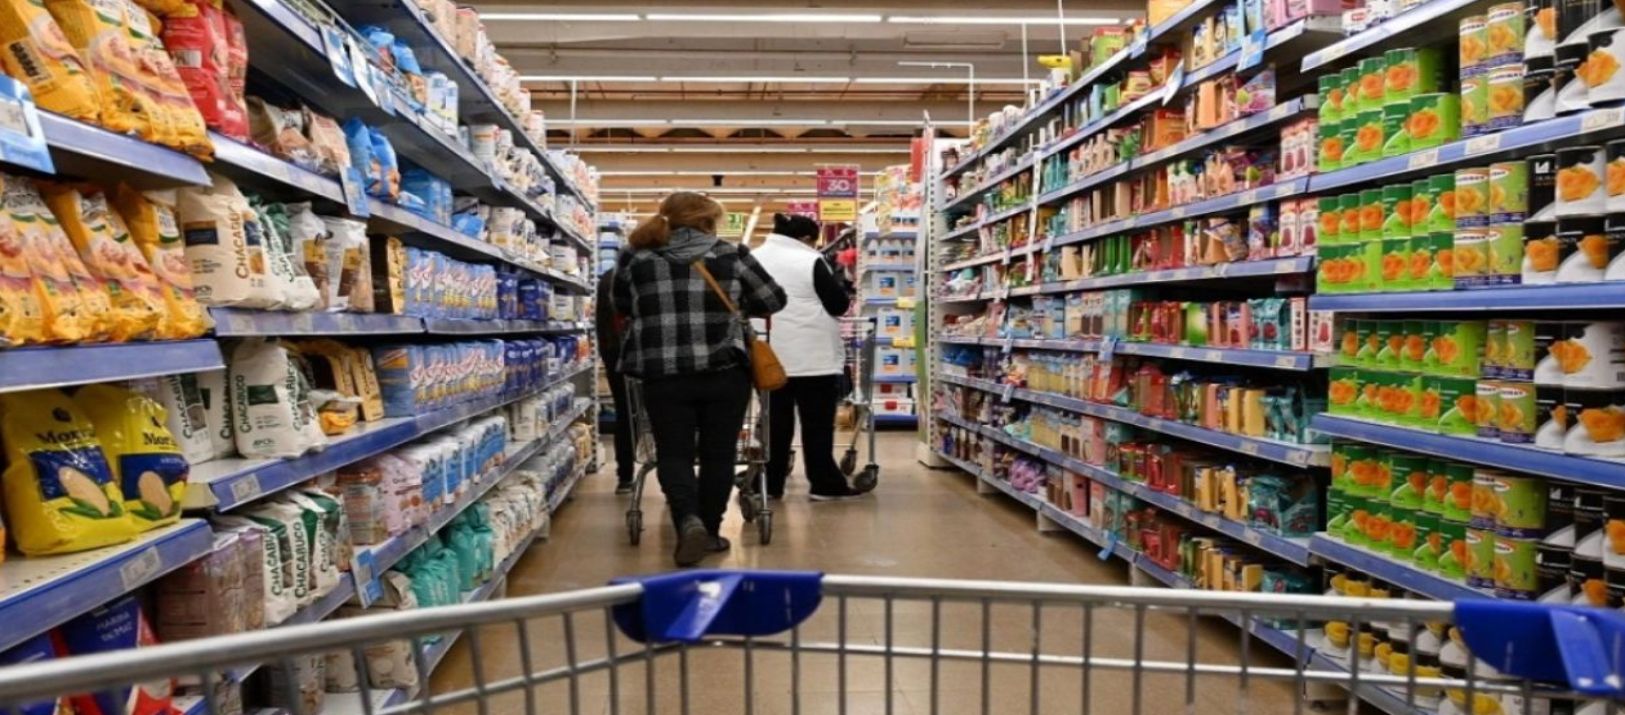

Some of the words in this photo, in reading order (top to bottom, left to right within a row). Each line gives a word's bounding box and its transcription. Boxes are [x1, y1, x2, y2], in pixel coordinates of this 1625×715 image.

[827, 179, 850, 192] 30
[235, 374, 252, 433] CHACABUCO
[292, 521, 308, 598] CHACABUCO
